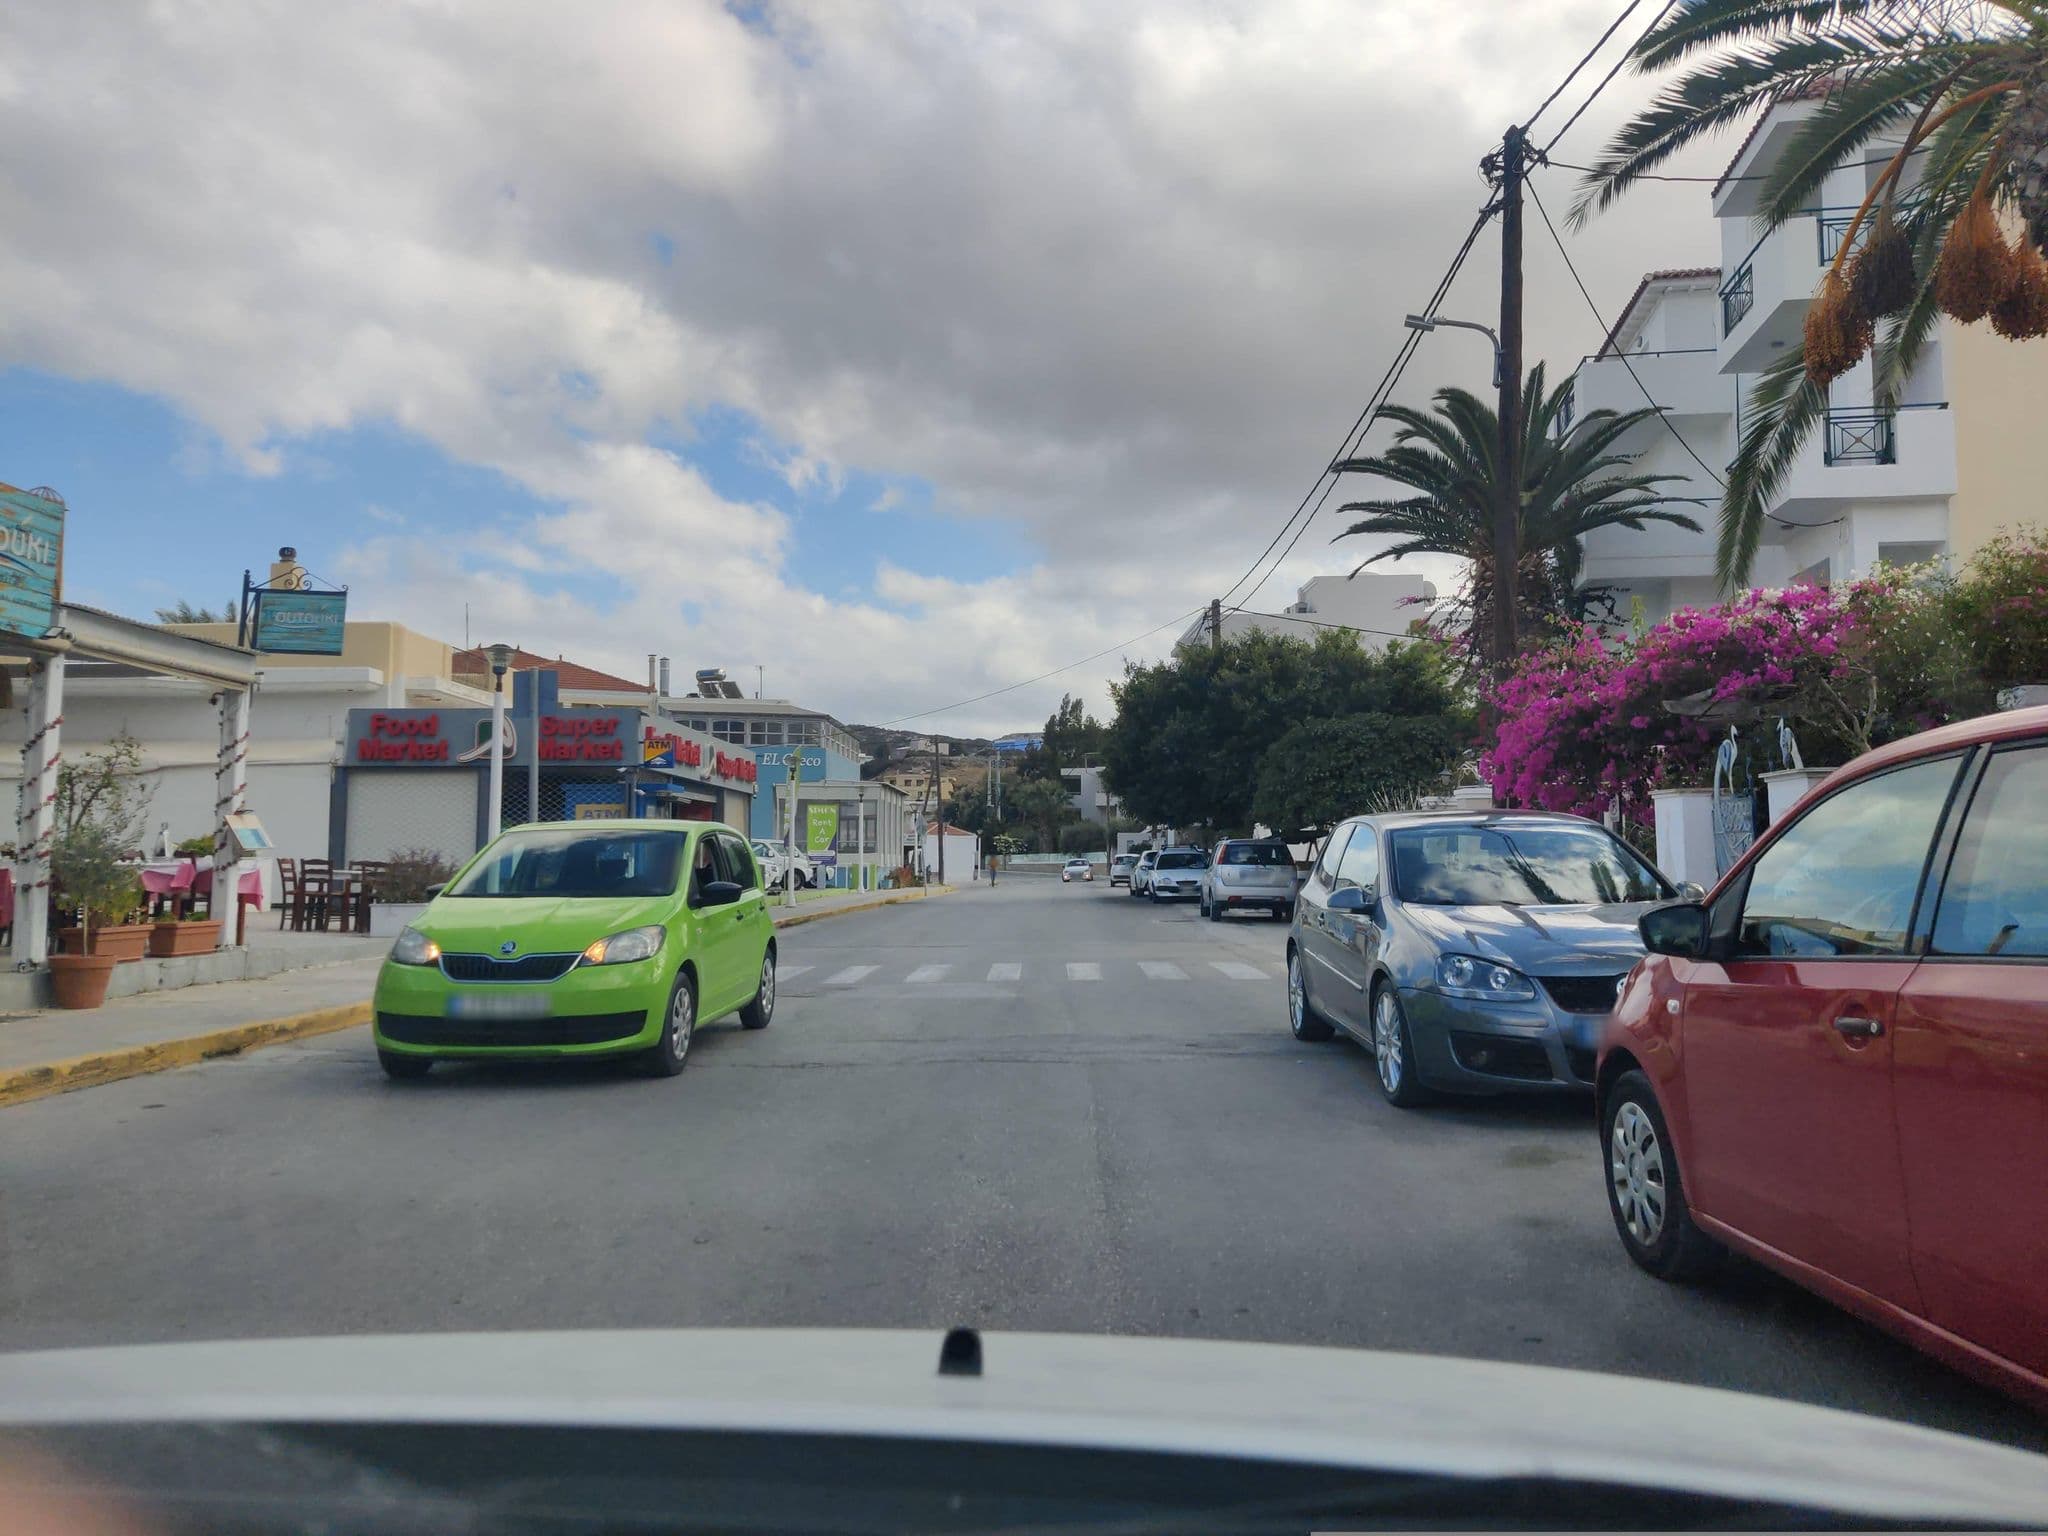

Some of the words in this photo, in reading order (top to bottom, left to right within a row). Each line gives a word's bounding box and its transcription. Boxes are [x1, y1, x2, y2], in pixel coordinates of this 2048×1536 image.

[370, 713, 439, 736] Food
[539, 715, 619, 739] Super
[358, 737, 449, 761] Market
[537, 738, 623, 761] Market
[647, 740, 672, 750] ATM
[762, 752, 780, 766] EL
[783, 753, 821, 767] Geco
[812, 818, 832, 827] Rent
[819, 827, 826, 835] A
